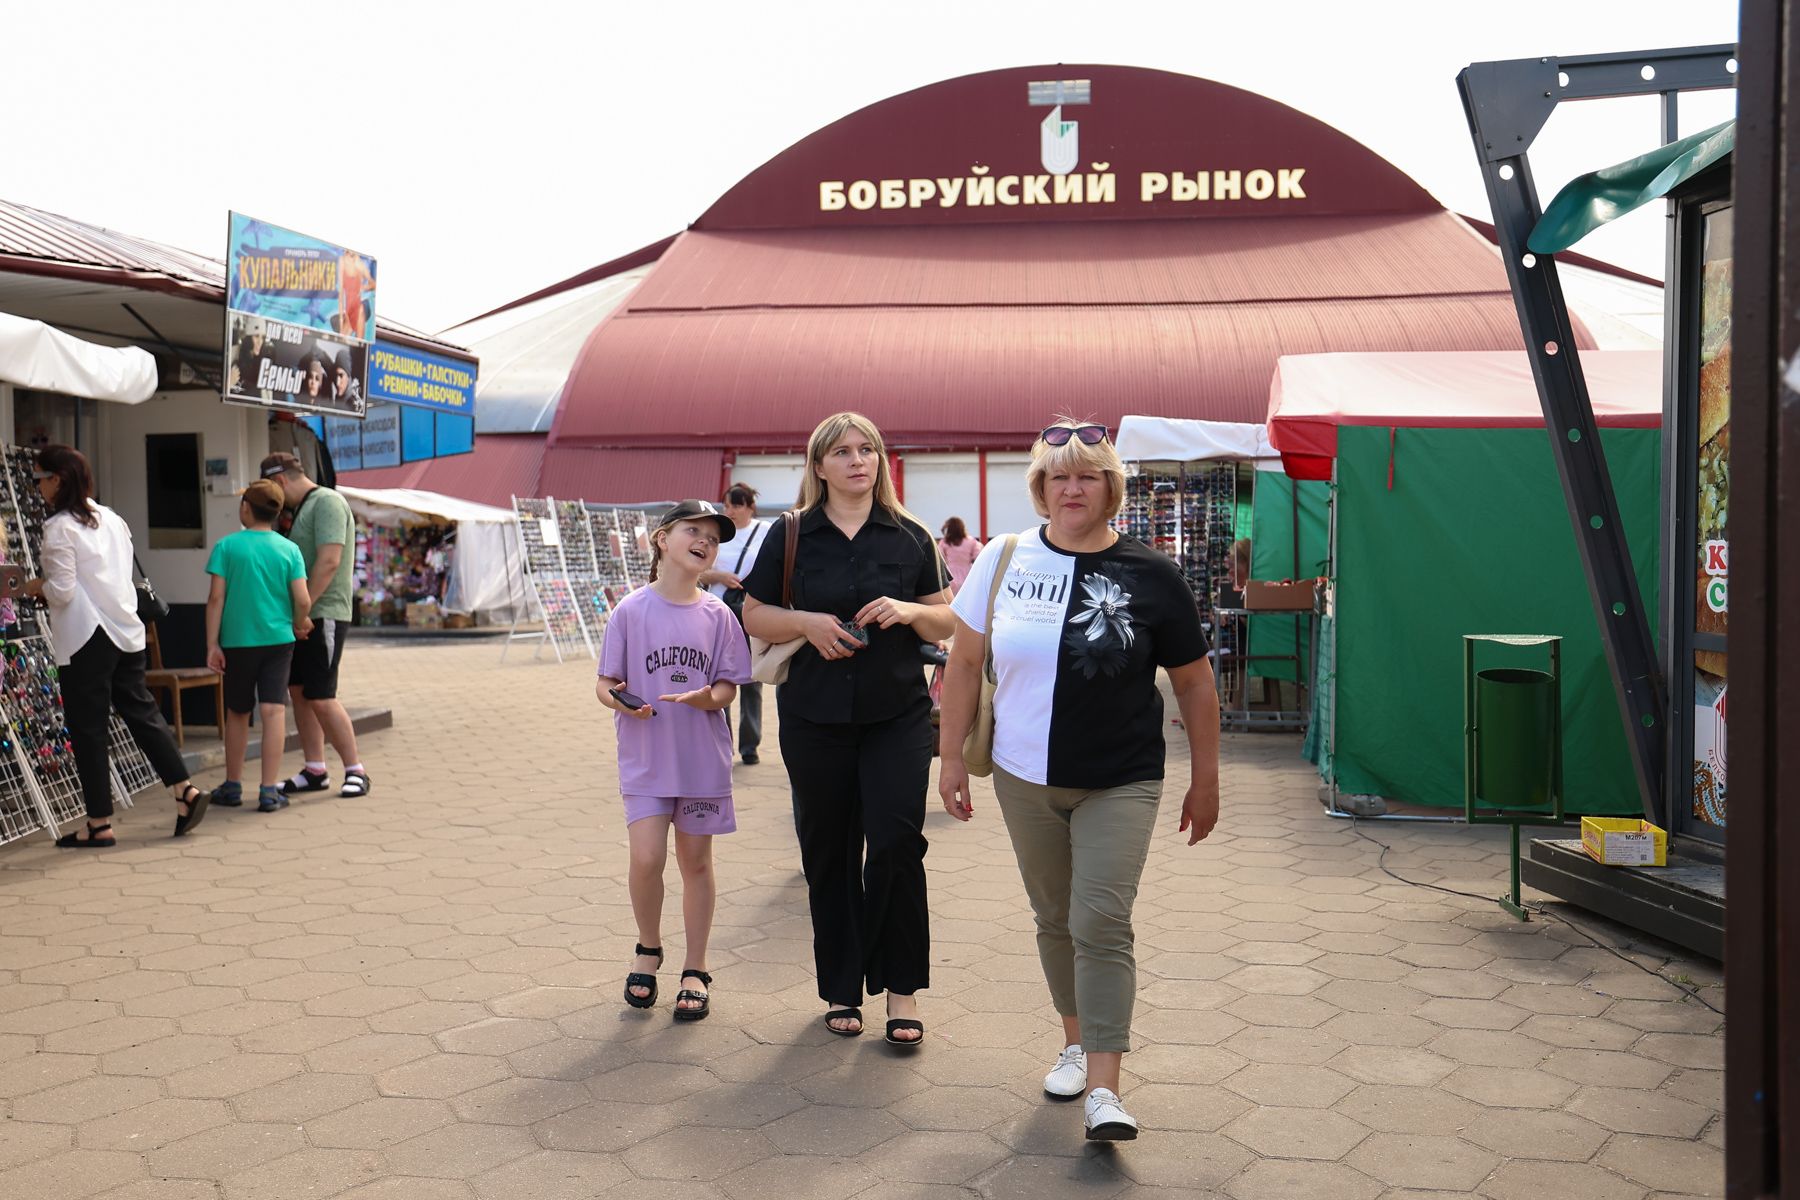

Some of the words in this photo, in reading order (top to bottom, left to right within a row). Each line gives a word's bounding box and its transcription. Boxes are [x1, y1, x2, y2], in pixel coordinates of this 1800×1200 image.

[820, 162, 1116, 211] БОБРУЙСКИЙ
[1141, 168, 1307, 202] РЫНОК
[240, 255, 336, 291] КУПАЛЬНИКИ
[375, 350, 423, 378] РУБАШКИ
[427, 363, 470, 389] ГАЛСТУКИ
[384, 374, 418, 398] РЕМНИ
[422, 382, 463, 407] БАБОЧКИ
[1007, 574, 1068, 605] soul
[682, 801, 720, 816] CALIFORNIA
